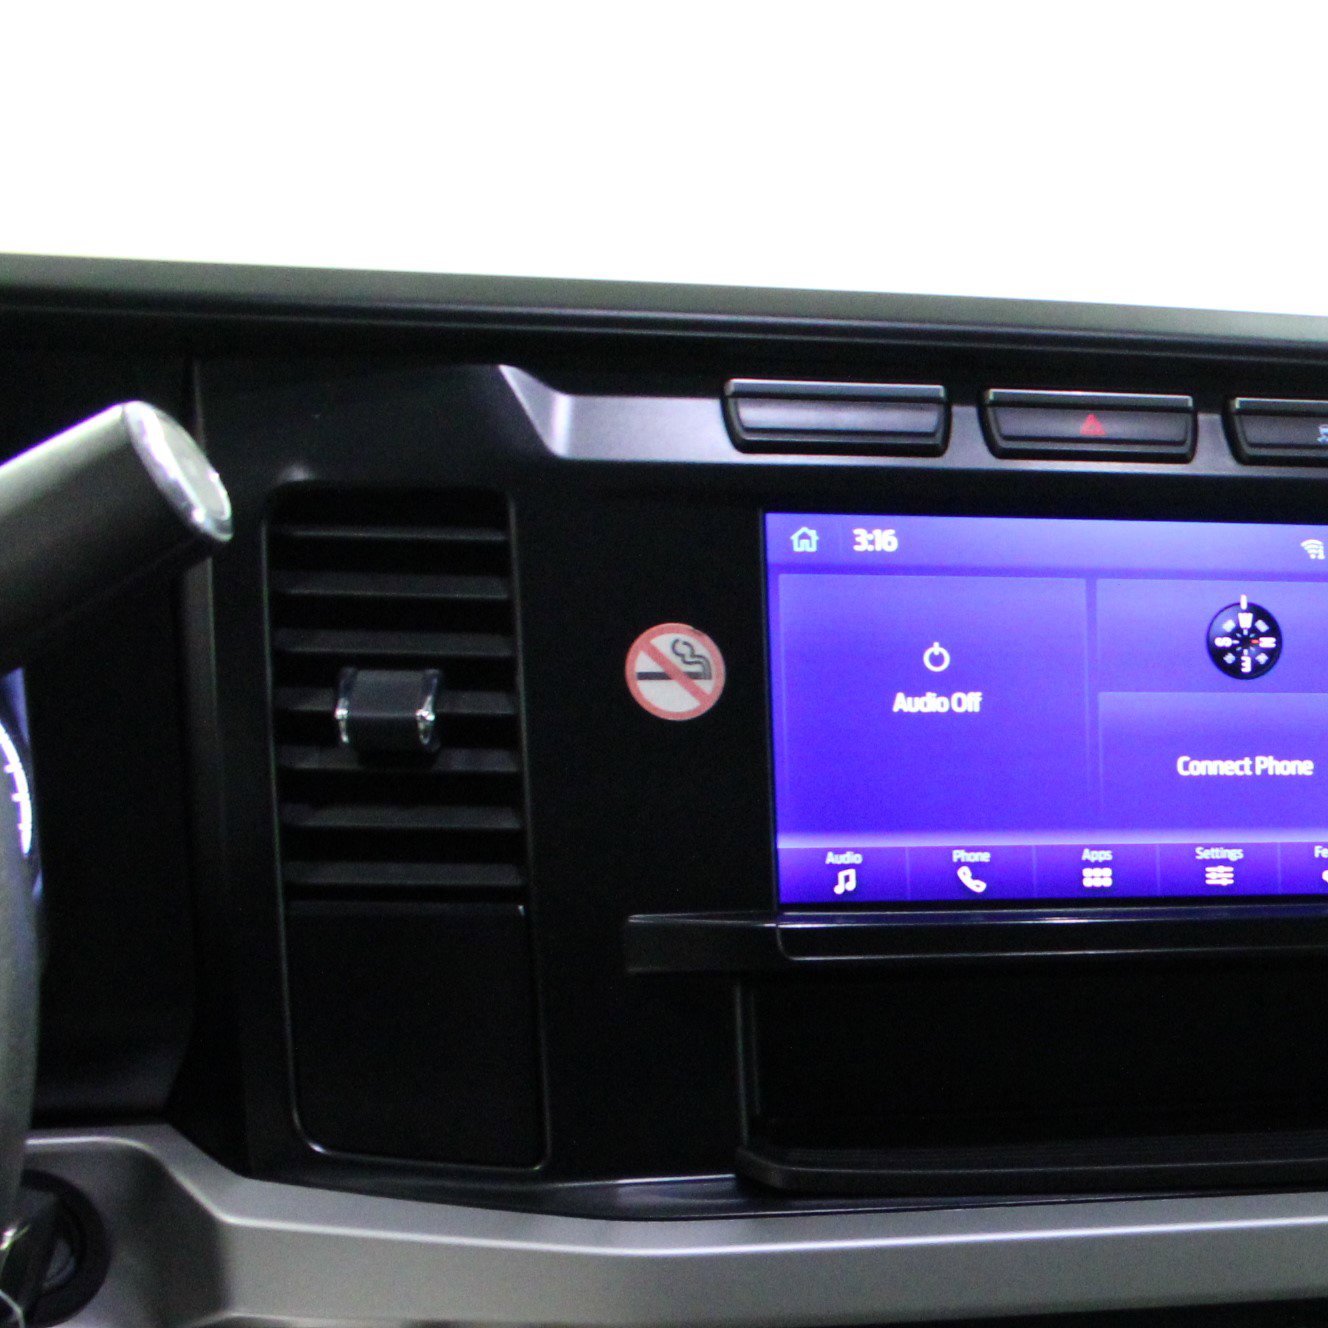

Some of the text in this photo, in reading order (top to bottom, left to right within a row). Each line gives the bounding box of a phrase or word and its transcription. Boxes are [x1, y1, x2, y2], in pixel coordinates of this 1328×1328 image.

[852, 528, 899, 552] 3:16
[892, 691, 983, 713] Audio Off
[1176, 755, 1315, 776] Connect Phone
[825, 851, 863, 865] Audio
[952, 849, 991, 863] Phone
[1082, 848, 1113, 862] Apps
[1195, 846, 1244, 861] Settings
